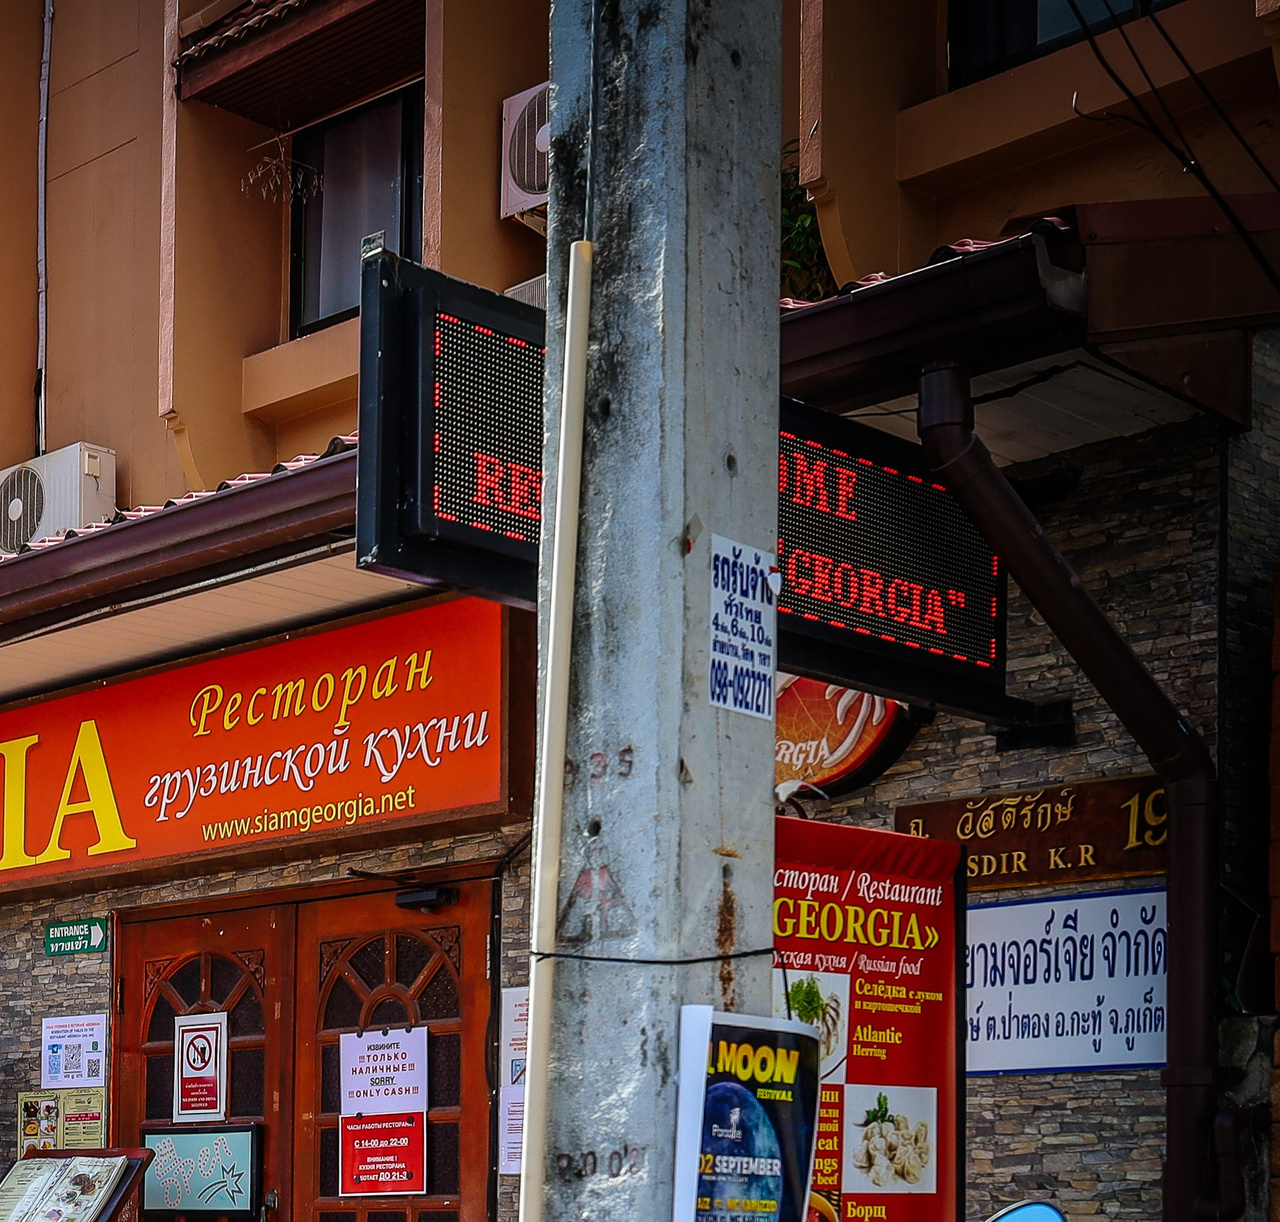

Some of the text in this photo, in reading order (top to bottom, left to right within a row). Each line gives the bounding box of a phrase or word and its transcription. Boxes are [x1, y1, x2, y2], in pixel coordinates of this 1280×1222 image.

[189, 649, 433, 738] Ресторан
[144, 709, 490, 822] грузинской кухни
[201, 785, 416, 842] www.siamgeorgia.net
[967, 852, 1028, 877] SDIR
[773, 868, 840, 899] сторан
[857, 872, 943, 906] Restaurant
[49, 924, 89, 938] ENTRANCE
[773, 897, 940, 950] GEORGIA»
[50, 936, 88, 952] ทางเข้า
[966, 905, 1167, 989] ยามจอร์เจีย จำกัด
[858, 954, 896, 974] Russian
[895, 956, 923, 979] food
[855, 978, 907, 999] Селёдка
[986, 992, 1050, 1041] ต.ป่าตอง
[1109, 986, 1164, 1051] จ.ภูเก็ต
[853, 1025, 902, 1044] Atlantic
[367, 1042, 401, 1052] ИЗВИНИТЕ
[853, 1044, 887, 1060] Herring
[717, 1040, 800, 1085] MOON
[370, 1076, 396, 1086] SORRY
[361, 1139, 379, 1148] 14-00
[389, 1137, 409, 1147] 22-00
[818, 1136, 839, 1151] eat
[715, 1155, 782, 1176] SEPTEMBER
[379, 1173, 391, 1182] ДО
[391, 1171, 408, 1181] 21-3
[817, 1173, 839, 1185] beef
[846, 1201, 887, 1221] Борщ
